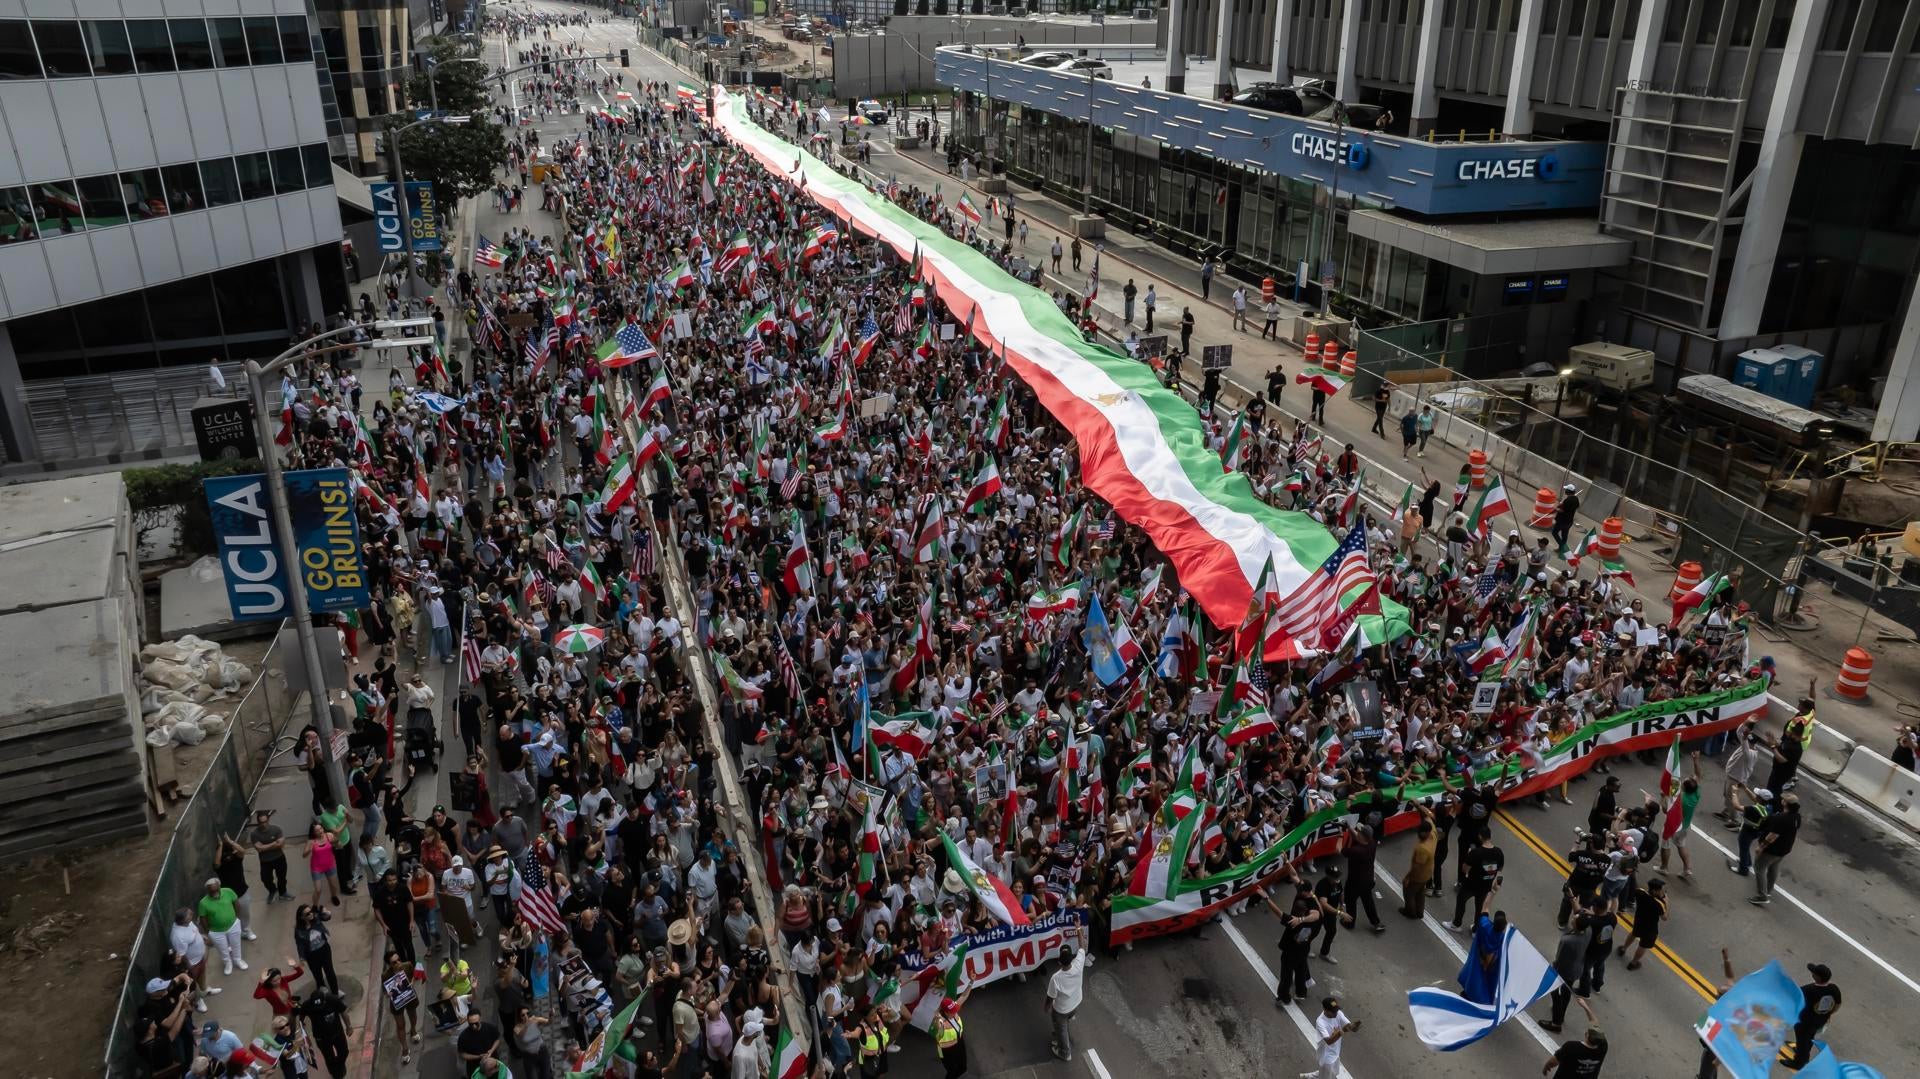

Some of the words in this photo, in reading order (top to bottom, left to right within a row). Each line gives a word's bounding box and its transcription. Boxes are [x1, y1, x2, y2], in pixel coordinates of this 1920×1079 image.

[1291, 131, 1348, 163] CHASE
[1459, 157, 1537, 181] CHASE
[374, 184, 403, 250] UCLA
[411, 217, 424, 239] GO
[419, 186, 437, 239] BRUINS!
[202, 410, 243, 427] UCLA
[205, 423, 244, 437] WILSHIRE
[207, 431, 245, 444] CENTER
[214, 481, 286, 615] UCLA
[319, 480, 362, 588] BRUINS!
[303, 547, 334, 591] GO
[1199, 818, 1341, 906] REGIME
[1571, 733, 1601, 760] IN
[1631, 706, 1719, 738] IRAN
[904, 952, 929, 968] We
[973, 929, 1008, 946] with
[955, 933, 1064, 987] UMP
